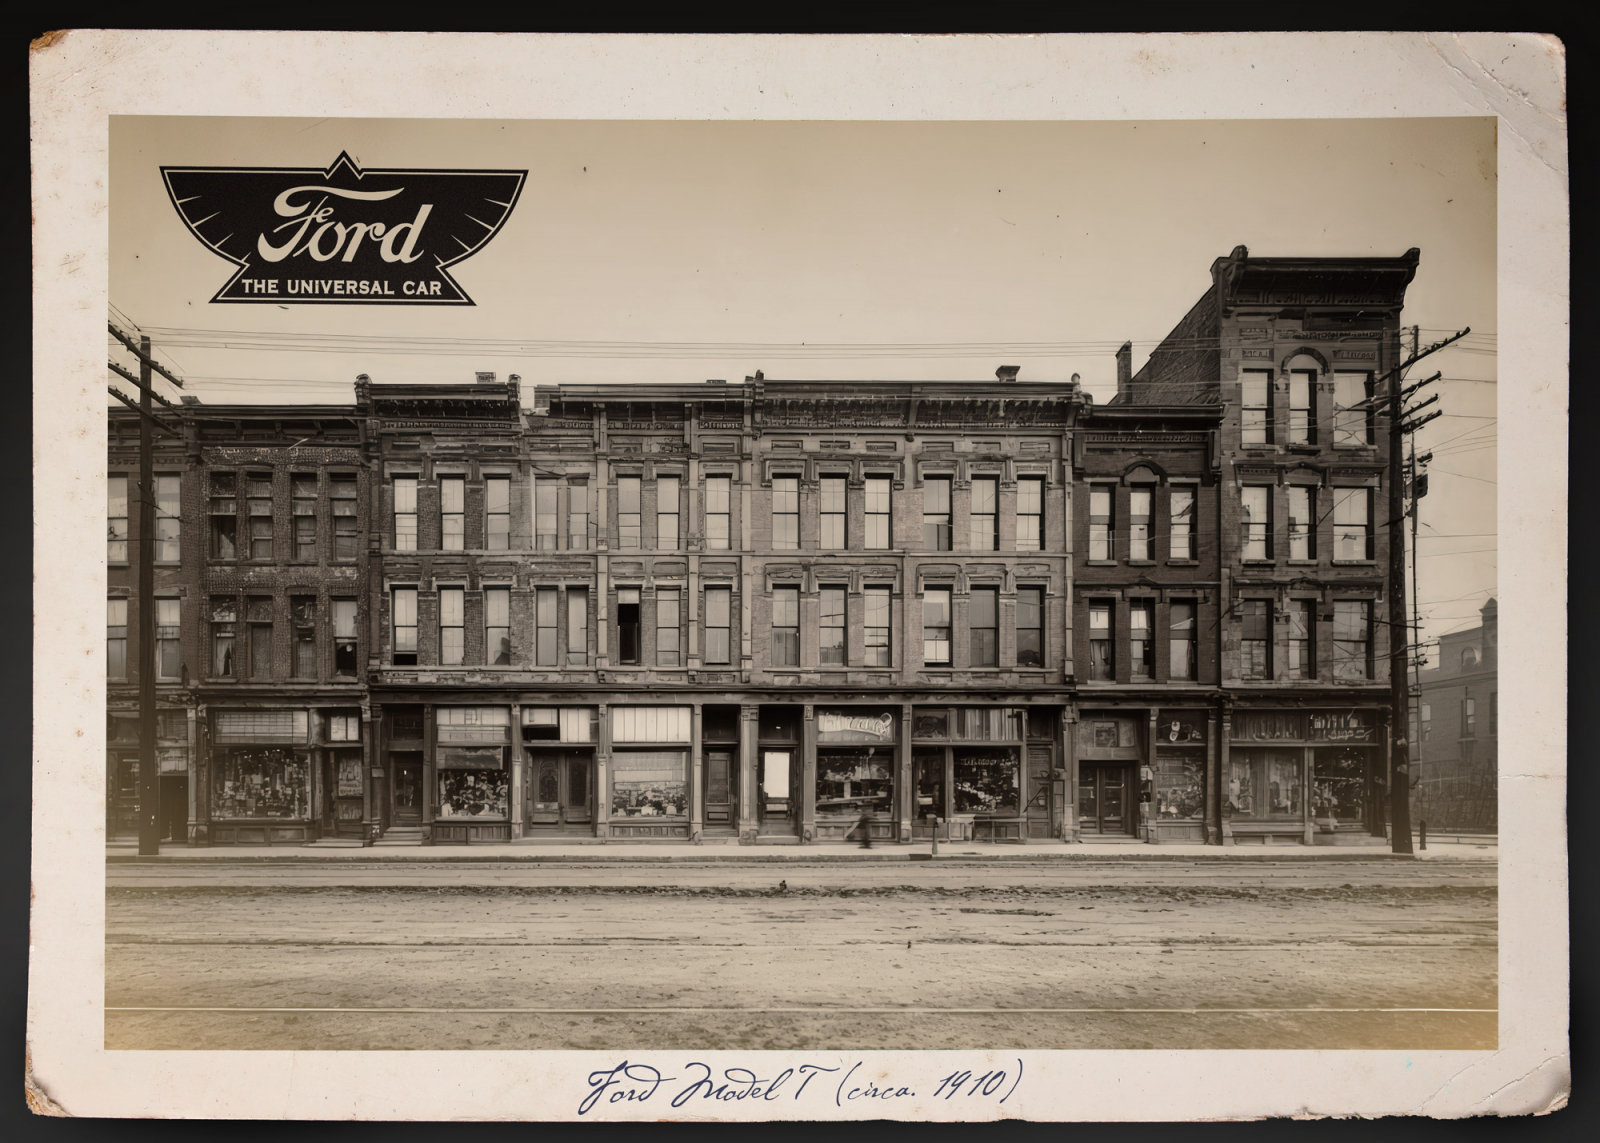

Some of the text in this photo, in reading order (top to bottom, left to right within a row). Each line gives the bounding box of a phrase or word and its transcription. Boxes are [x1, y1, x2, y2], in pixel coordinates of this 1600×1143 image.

[577, 1058, 1023, 1116] Ford Model T (circa. 1910)
